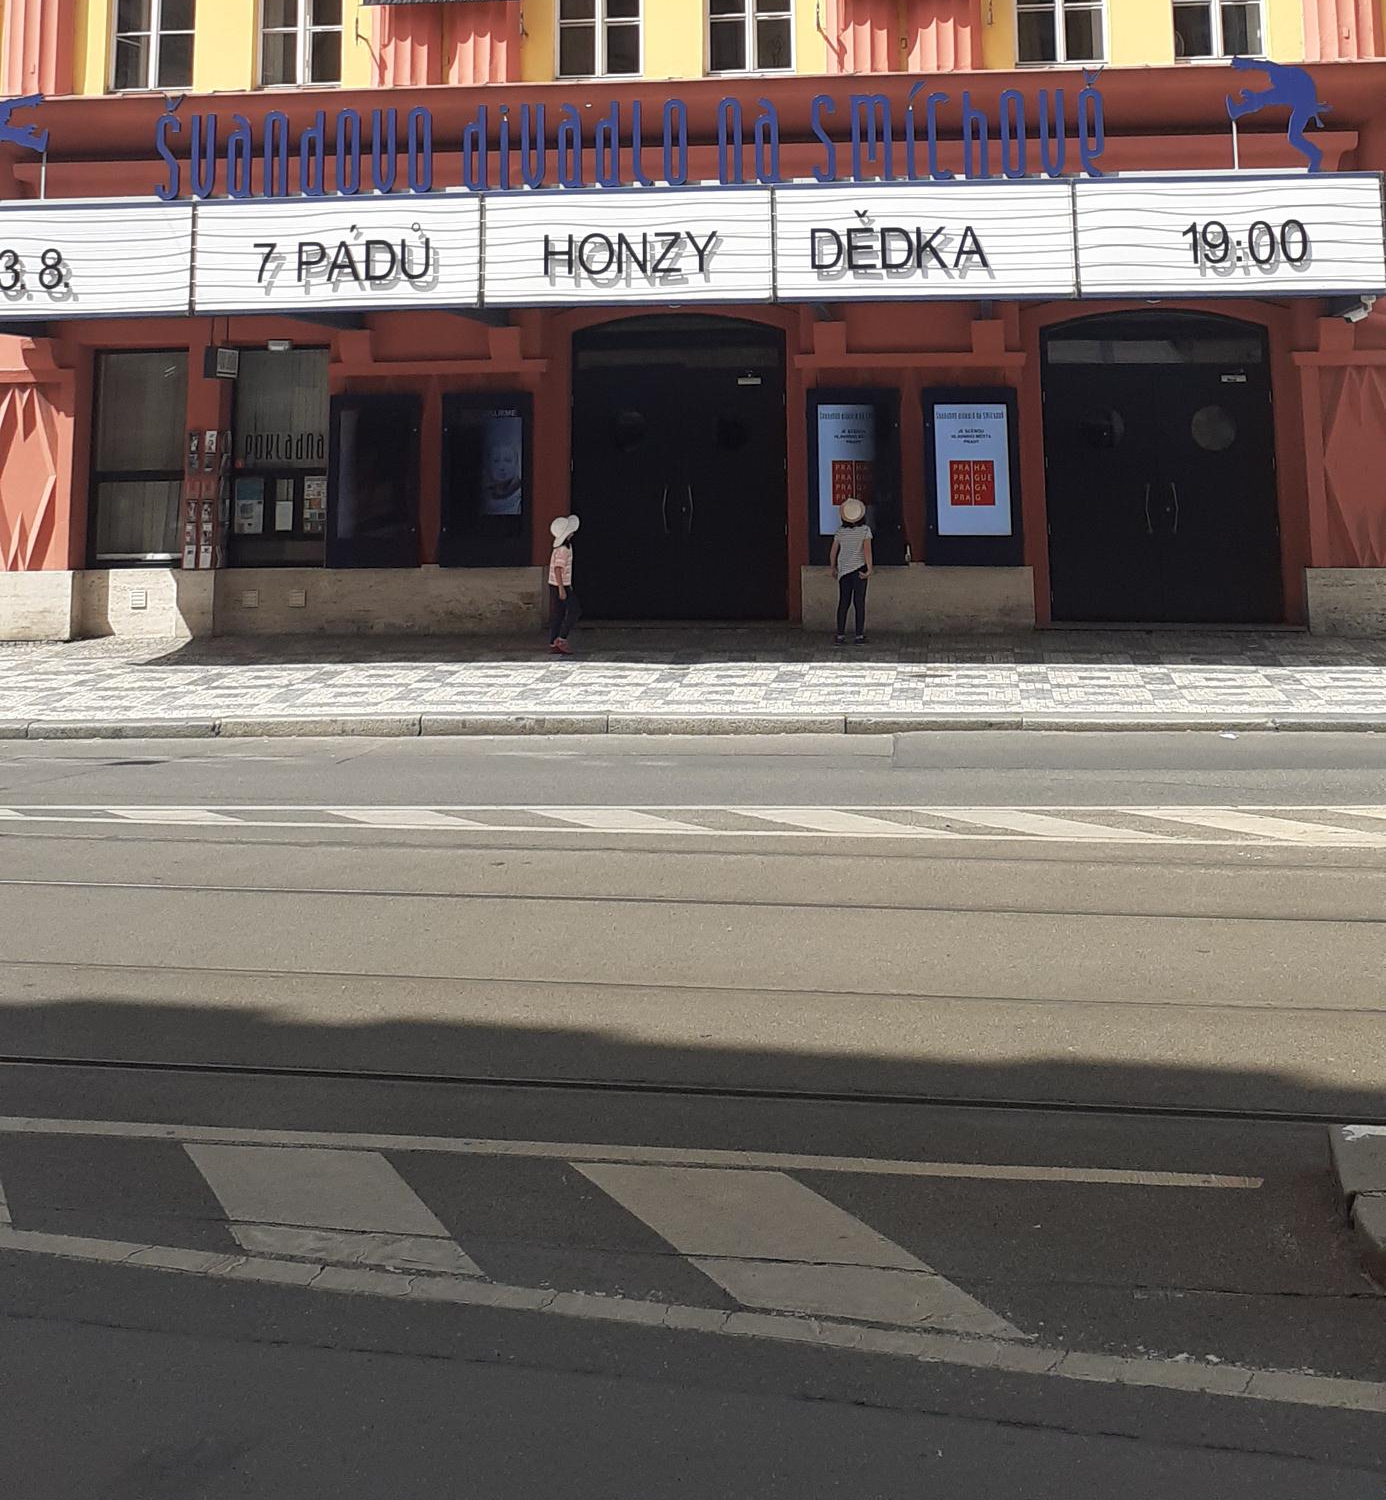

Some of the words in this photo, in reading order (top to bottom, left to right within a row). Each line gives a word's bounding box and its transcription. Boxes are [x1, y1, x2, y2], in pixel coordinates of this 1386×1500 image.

[463, 98, 688, 191] divadlo
[718, 97, 781, 185] na
[253, 242, 277, 283] 7
[297, 223, 431, 283] PÁDŮ
[544, 230, 718, 276] HONZY
[810, 209, 989, 272] DĚDKA
[1182, 218, 1308, 266] 19:00
